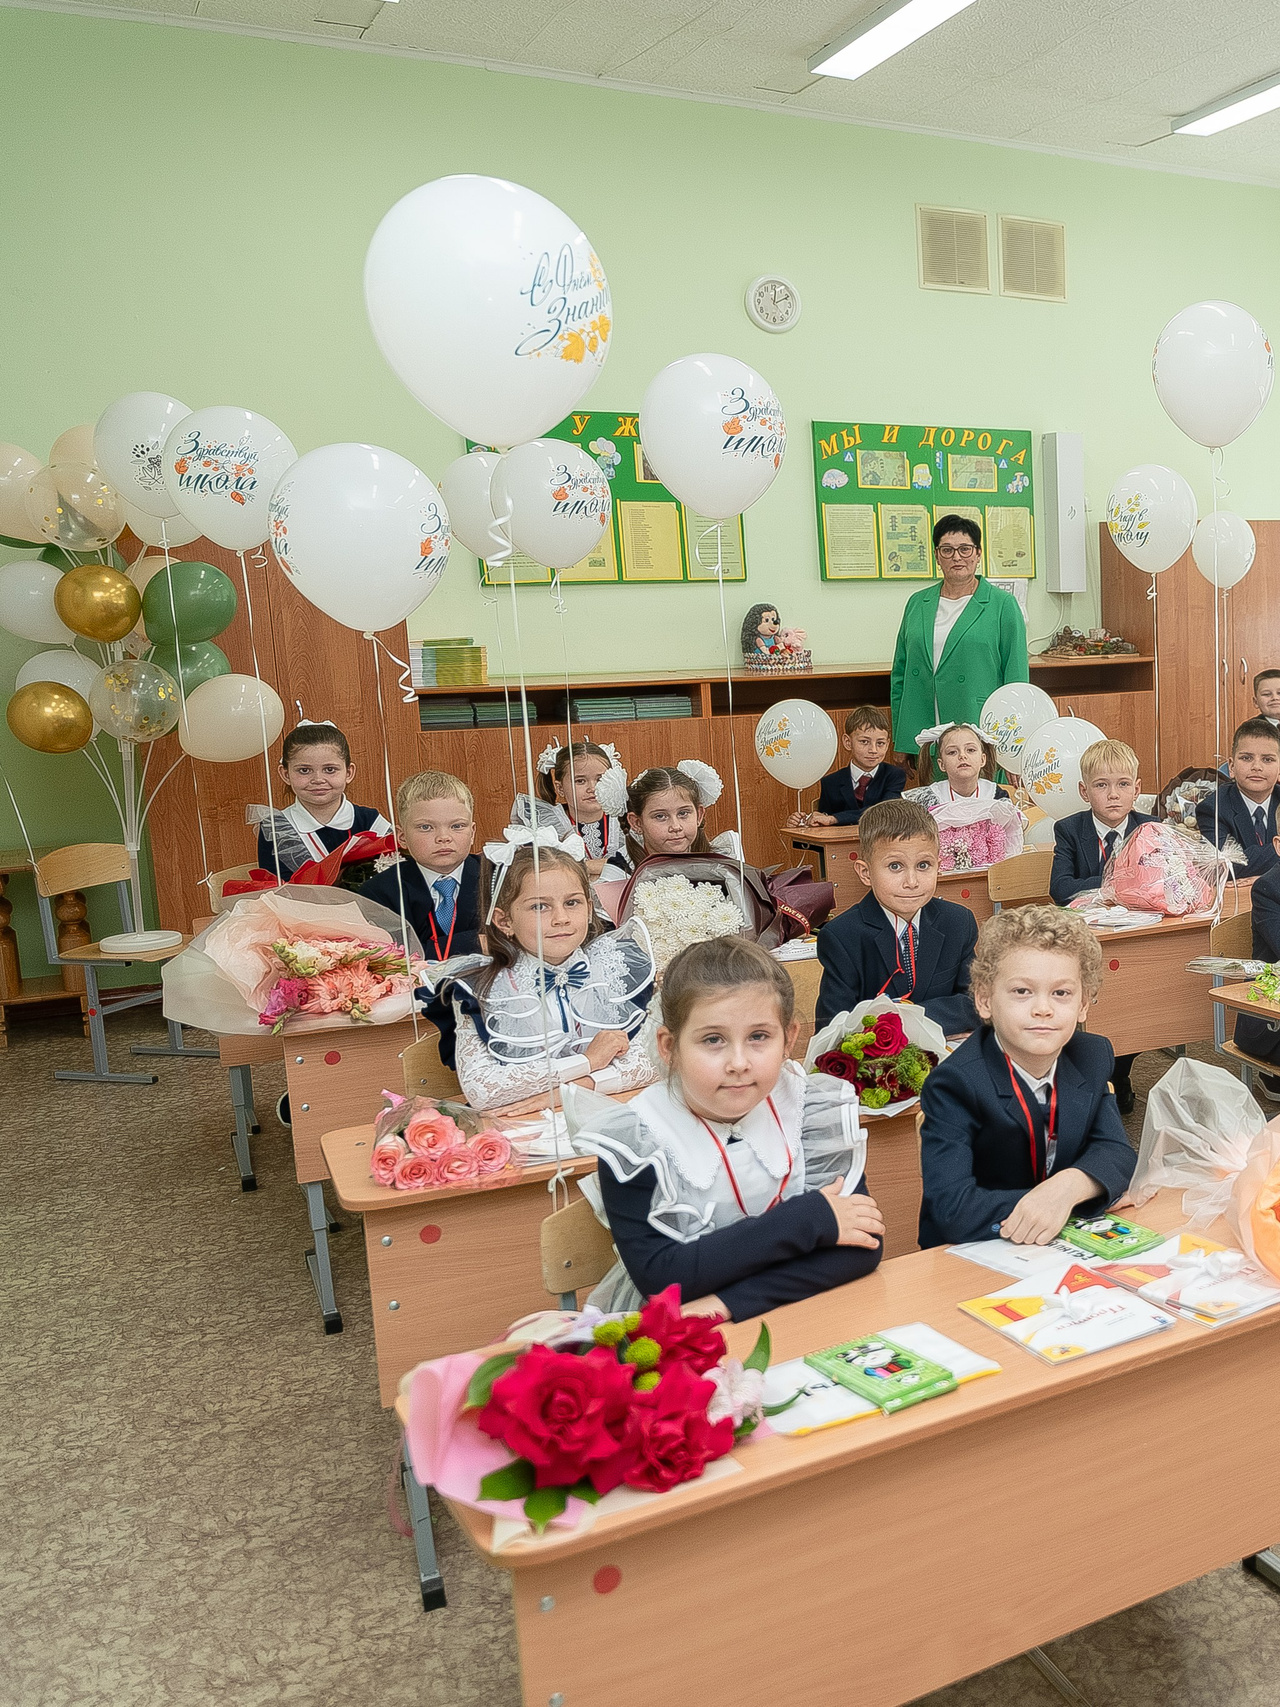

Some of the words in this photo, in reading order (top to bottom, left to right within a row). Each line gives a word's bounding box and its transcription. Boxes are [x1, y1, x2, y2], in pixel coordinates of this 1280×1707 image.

[175, 430, 259, 463] Здравствуй
[818, 423, 863, 460] МЫ
[881, 424, 901, 443] И
[918, 426, 1028, 466] ДОРОГА
